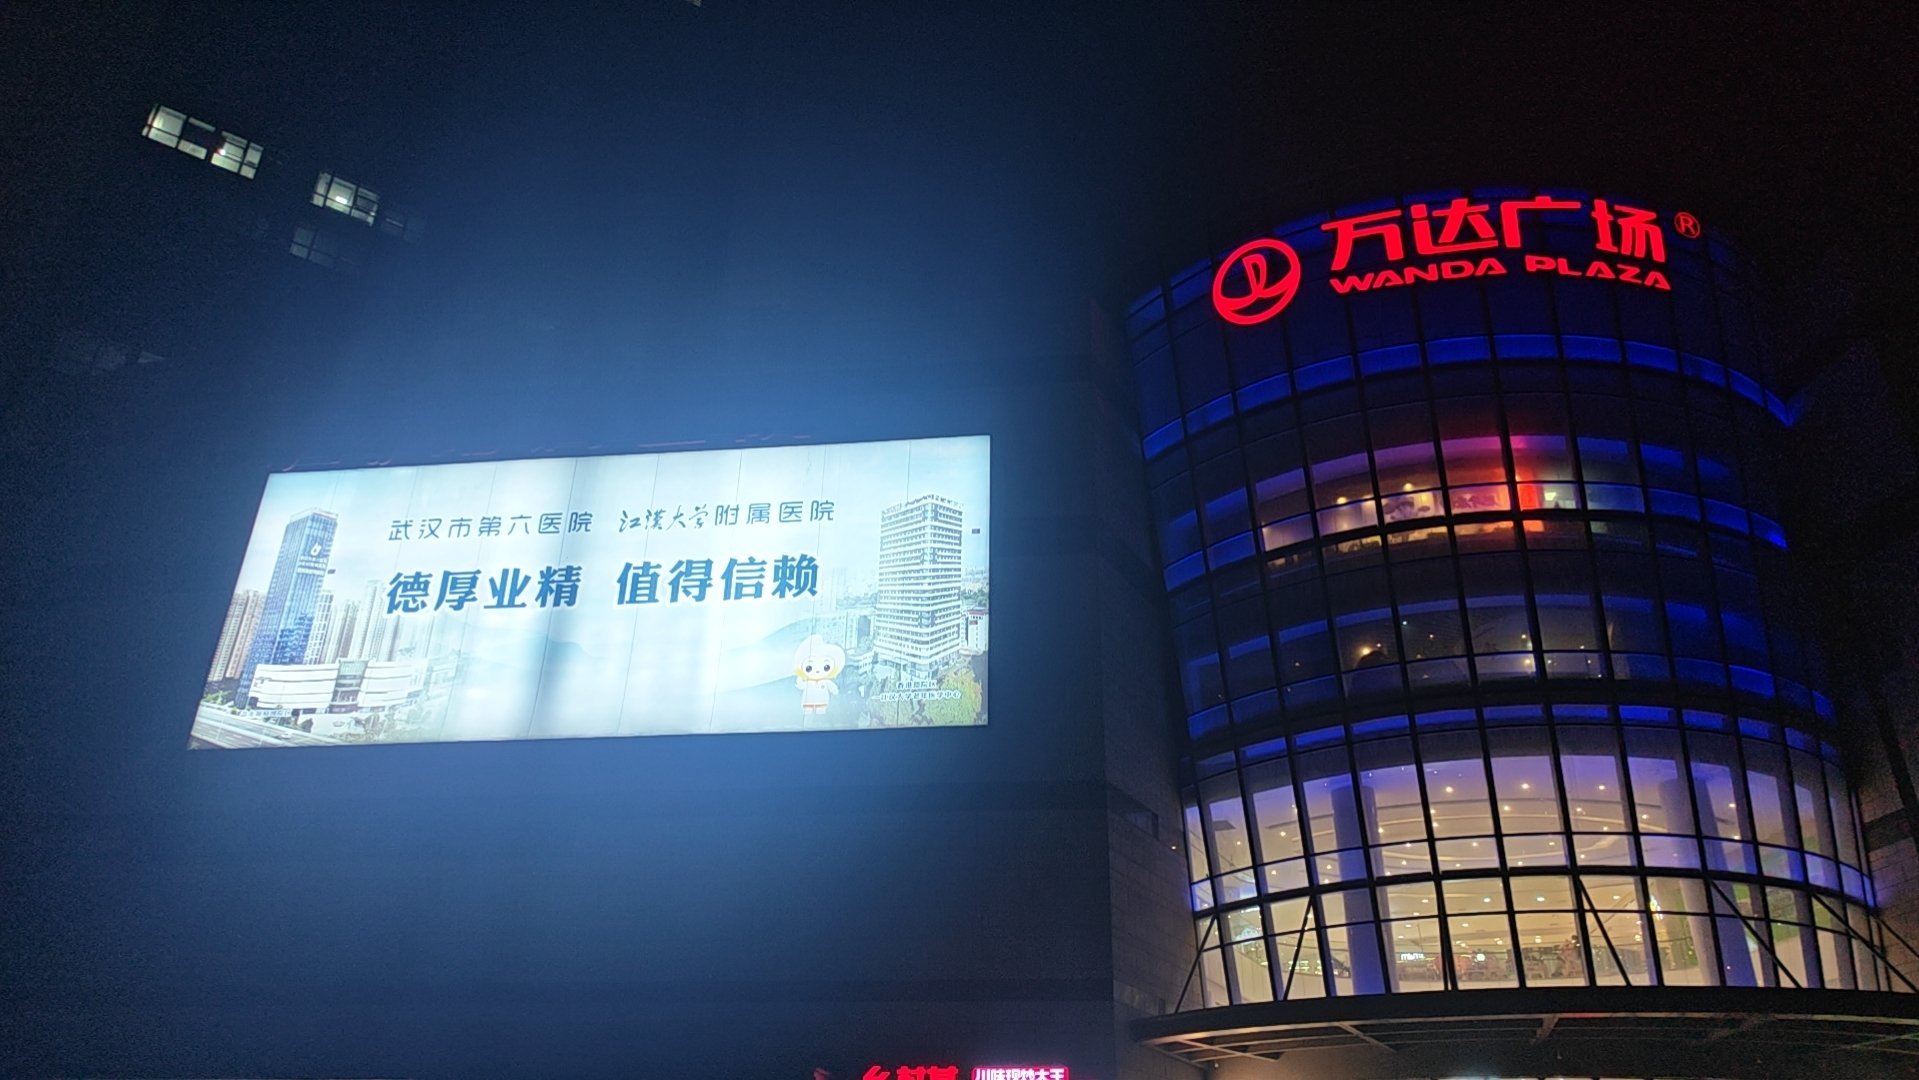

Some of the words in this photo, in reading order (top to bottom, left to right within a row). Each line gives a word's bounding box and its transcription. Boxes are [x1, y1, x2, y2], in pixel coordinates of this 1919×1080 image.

[1321, 196, 1667, 270] 万达广场
[1330, 257, 1508, 294] WANDA
[1525, 255, 1671, 290] PLAZA
[388, 511, 593, 541] 武汉市第六医院
[386, 565, 583, 614] 德厚业精
[616, 553, 819, 605] 值得信赖
